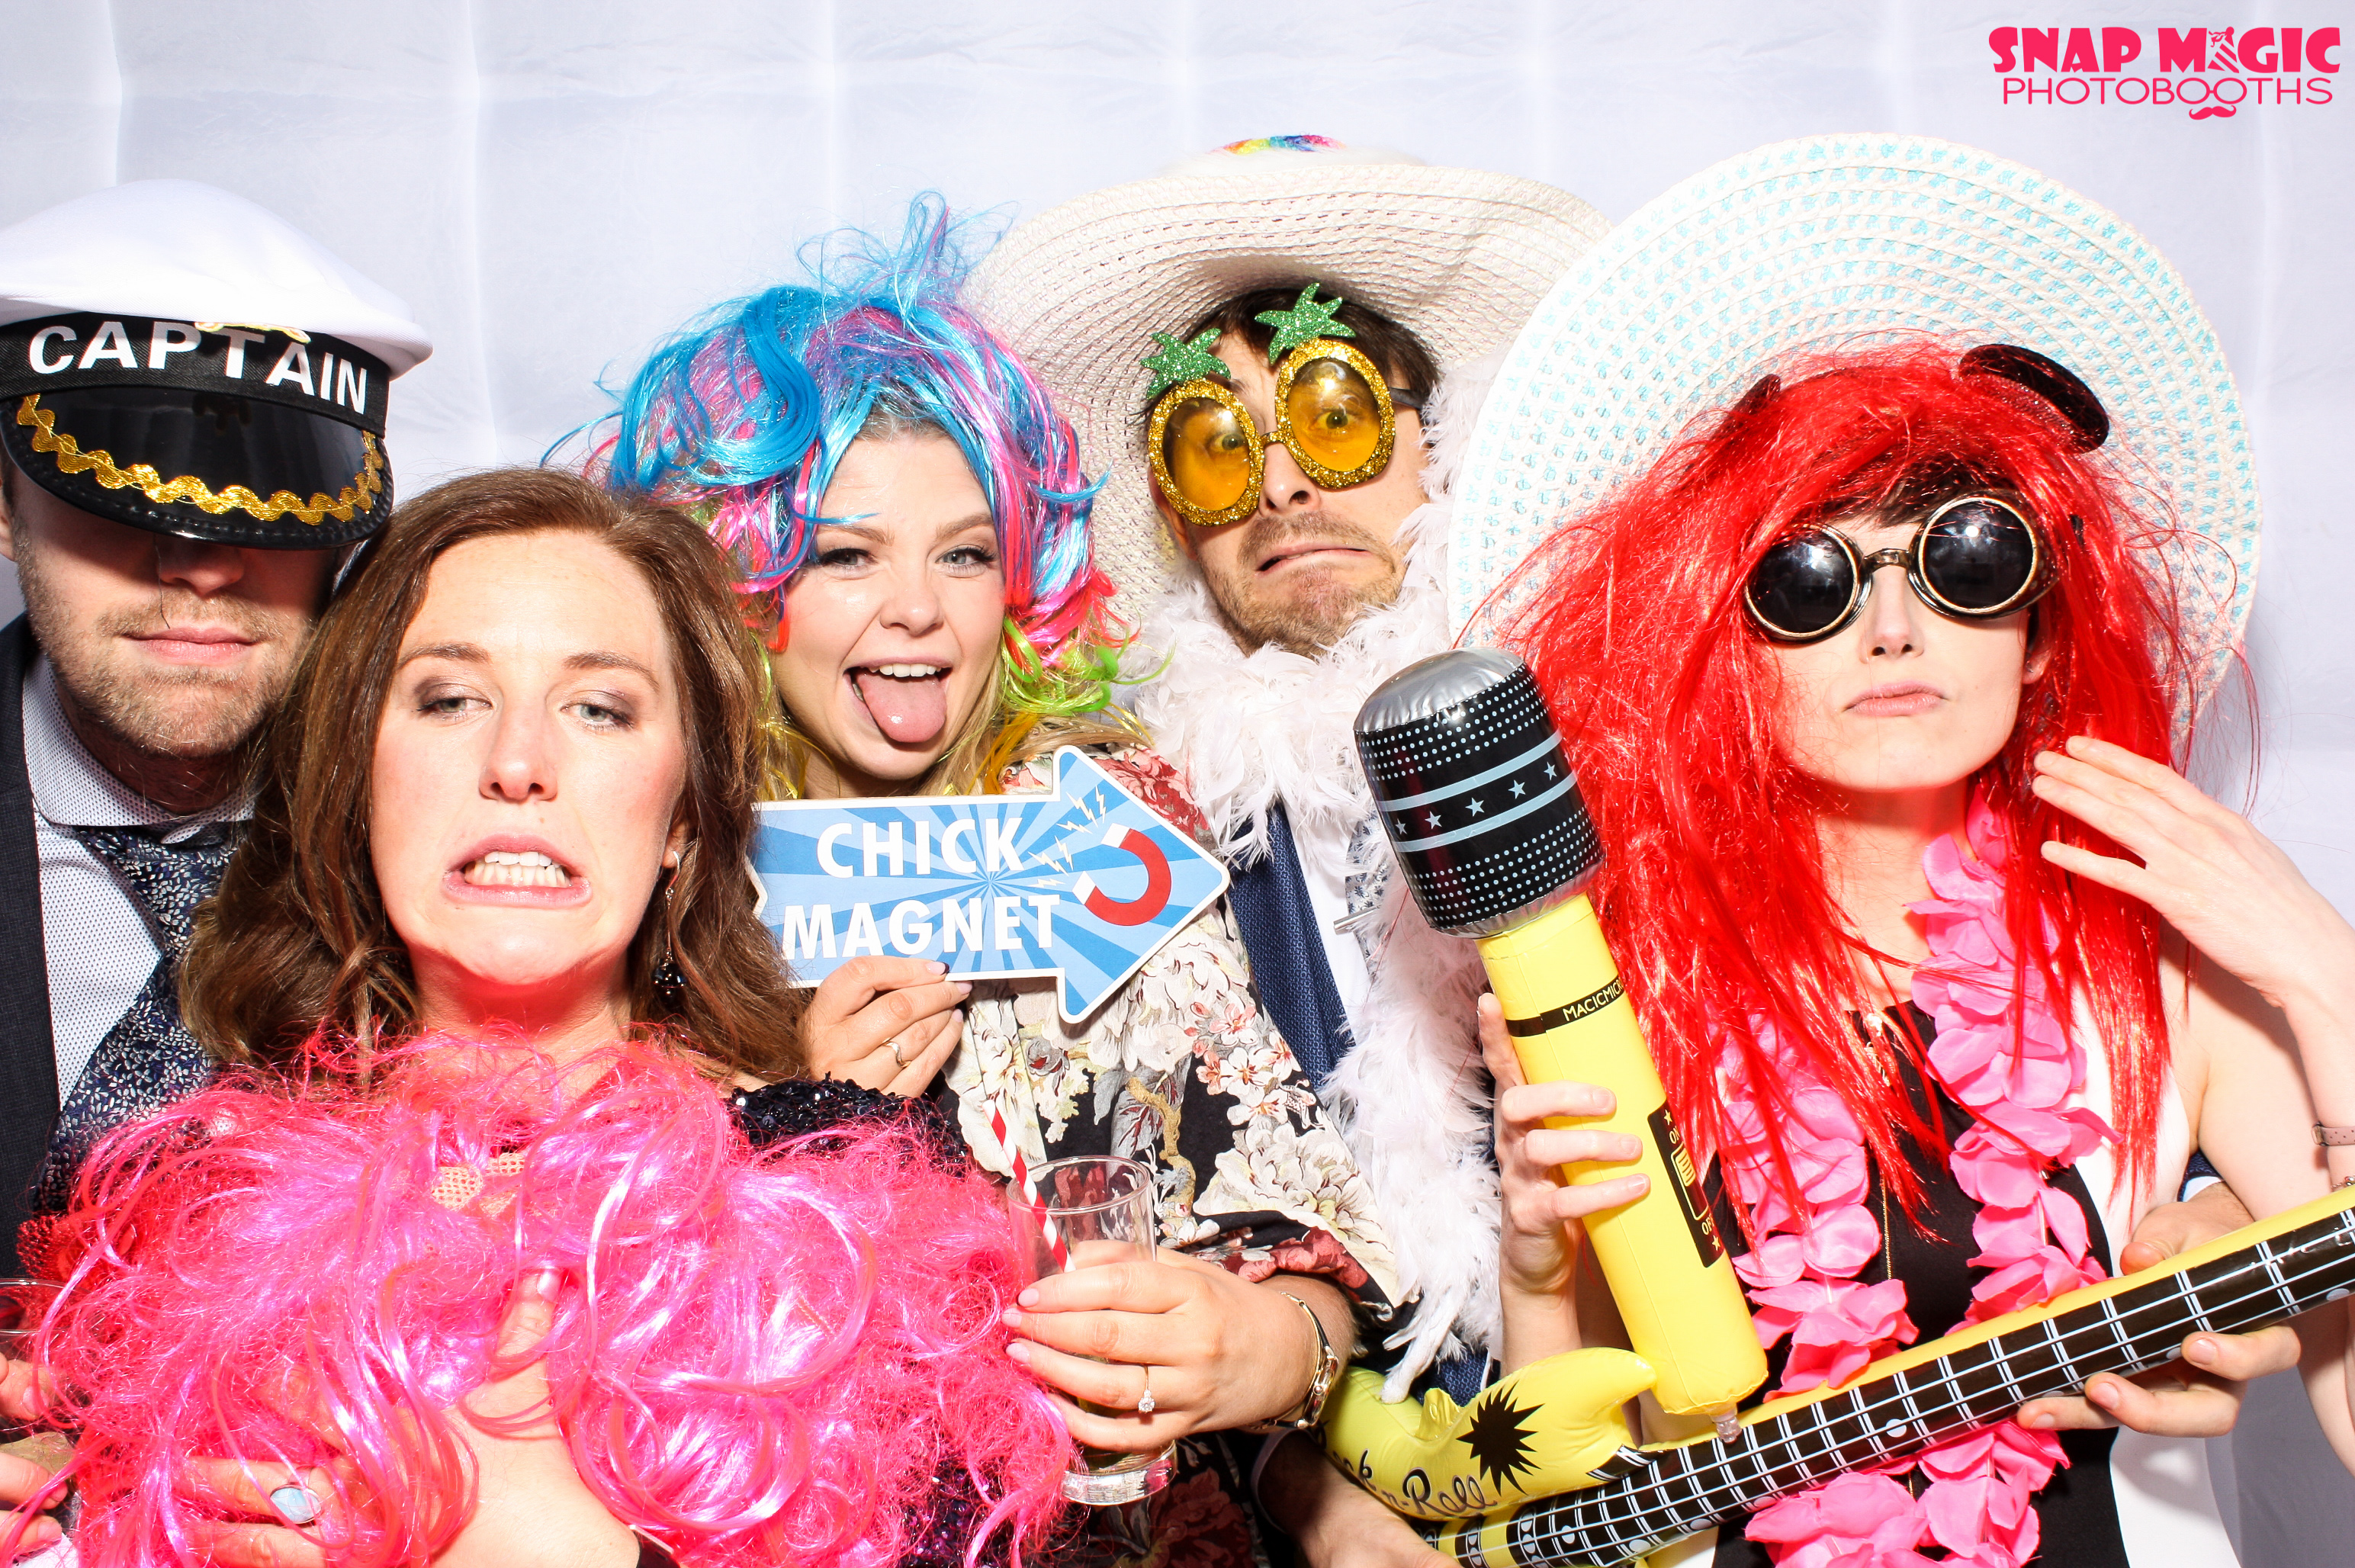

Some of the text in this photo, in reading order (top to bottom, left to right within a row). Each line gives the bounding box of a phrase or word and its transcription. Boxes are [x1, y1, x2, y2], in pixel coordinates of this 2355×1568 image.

[28, 320, 368, 415] CAPTAIN
[816, 817, 1024, 879] CHICK
[782, 894, 1061, 960] MAGNET
